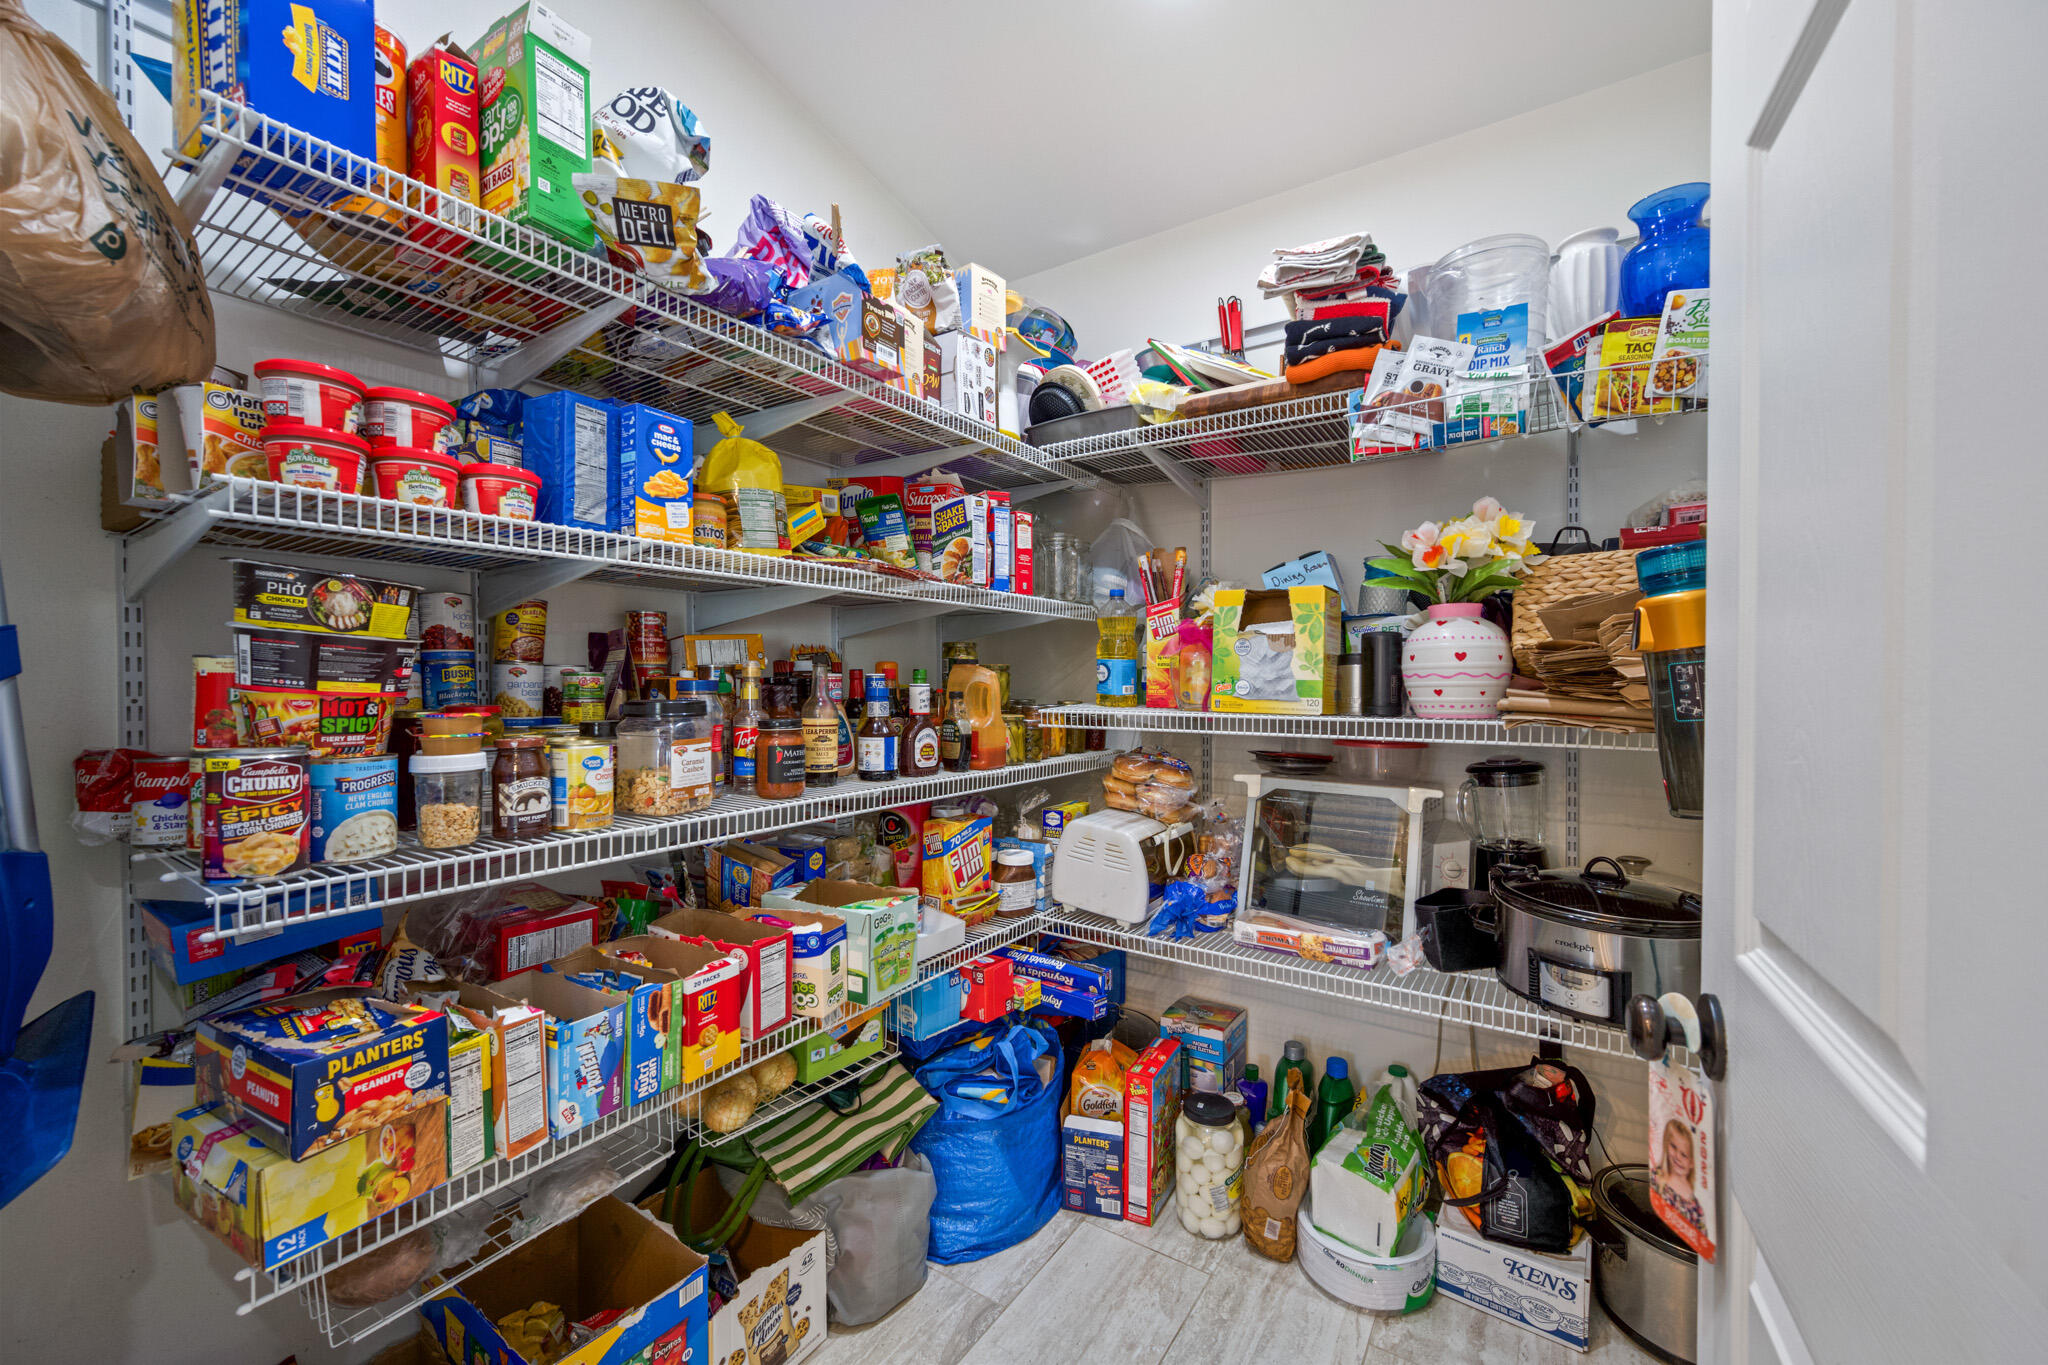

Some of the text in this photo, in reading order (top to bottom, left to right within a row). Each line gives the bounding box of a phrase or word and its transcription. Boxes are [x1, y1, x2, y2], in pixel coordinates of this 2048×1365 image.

[327, 35, 342, 69] ACT
[439, 58, 475, 94] RITZ
[618, 202, 667, 223] METRO
[1461, 335, 1469, 345] 4
[1625, 342, 1656, 354] TAC
[1476, 344, 1507, 355] Ranch
[1413, 363, 1454, 378] GRAVY
[1468, 358, 1488, 372] DIP
[1490, 354, 1511, 368] MIX
[653, 432, 673, 443] mac
[840, 488, 873, 510] inute
[908, 491, 947, 506] Success
[935, 504, 965, 525] SHAKE
[942, 514, 966, 534] BAKE
[1271, 561, 1328, 588] Dining Room
[265, 595, 304, 605] CHICKEN
[521, 687, 543, 696] bean
[322, 700, 378, 717] HOT &
[1306, 698, 1319, 708] 120
[321, 717, 377, 734] SPICY
[320, 735, 366, 743] FIERY BEEF
[134, 771, 190, 790] Campb
[241, 766, 289, 777] Campbell's
[227, 775, 299, 793] CHUNKY
[341, 772, 395, 793] PROGRESSO
[345, 798, 394, 810] CLAM CHOWDER
[348, 791, 393, 803] NEW ENGLAND
[152, 813, 187, 823] Chicke
[222, 799, 303, 824] SPICY
[222, 810, 303, 831] CHIPOTLE CHICKEN
[533, 814, 547, 822] FUDGE
[153, 821, 187, 831] & Star
[236, 824, 262, 836] CORN
[264, 815, 303, 832] CHOWDER
[950, 835, 961, 848] 70
[1352, 889, 1385, 904] Showtime
[1325, 943, 1349, 955] CINNAMON
[1555, 938, 1594, 953] crockpot
[1007, 950, 1066, 971] Reynolds Wrap
[694, 973, 720, 988] 20 PACKS
[1029, 968, 1074, 987] Reynolds
[698, 990, 717, 1011] RITZ
[505, 1019, 538, 1035] Nutrition Facts
[328, 1030, 427, 1079] PLANTERS
[506, 1040, 527, 1051] Calories
[576, 1041, 606, 1097] PROTEIN
[648, 1057, 658, 1093] Grain
[354, 1069, 404, 1095] PEANUTS
[636, 1060, 649, 1099] Nutri
[246, 1080, 280, 1108] PEANUTS
[1083, 1099, 1117, 1111] Goldfish
[1074, 1136, 1110, 1149] PLANTERS
[1364, 1143, 1391, 1181] Bounty
[277, 1233, 297, 1259] 12
[298, 1228, 307, 1249] PACK
[801, 1253, 814, 1267] 42
[1503, 1257, 1578, 1301] KEN'S
[1511, 1276, 1525, 1286] Family
[1525, 1281, 1539, 1291] Owned
[1539, 1286, 1559, 1299] Company
[1489, 1300, 1508, 1314] CONTROL
[1509, 1308, 1521, 1320] CUPS
[748, 1300, 784, 1348] Famous
[753, 1314, 782, 1355] Amos
[654, 1335, 682, 1360] Doritos
